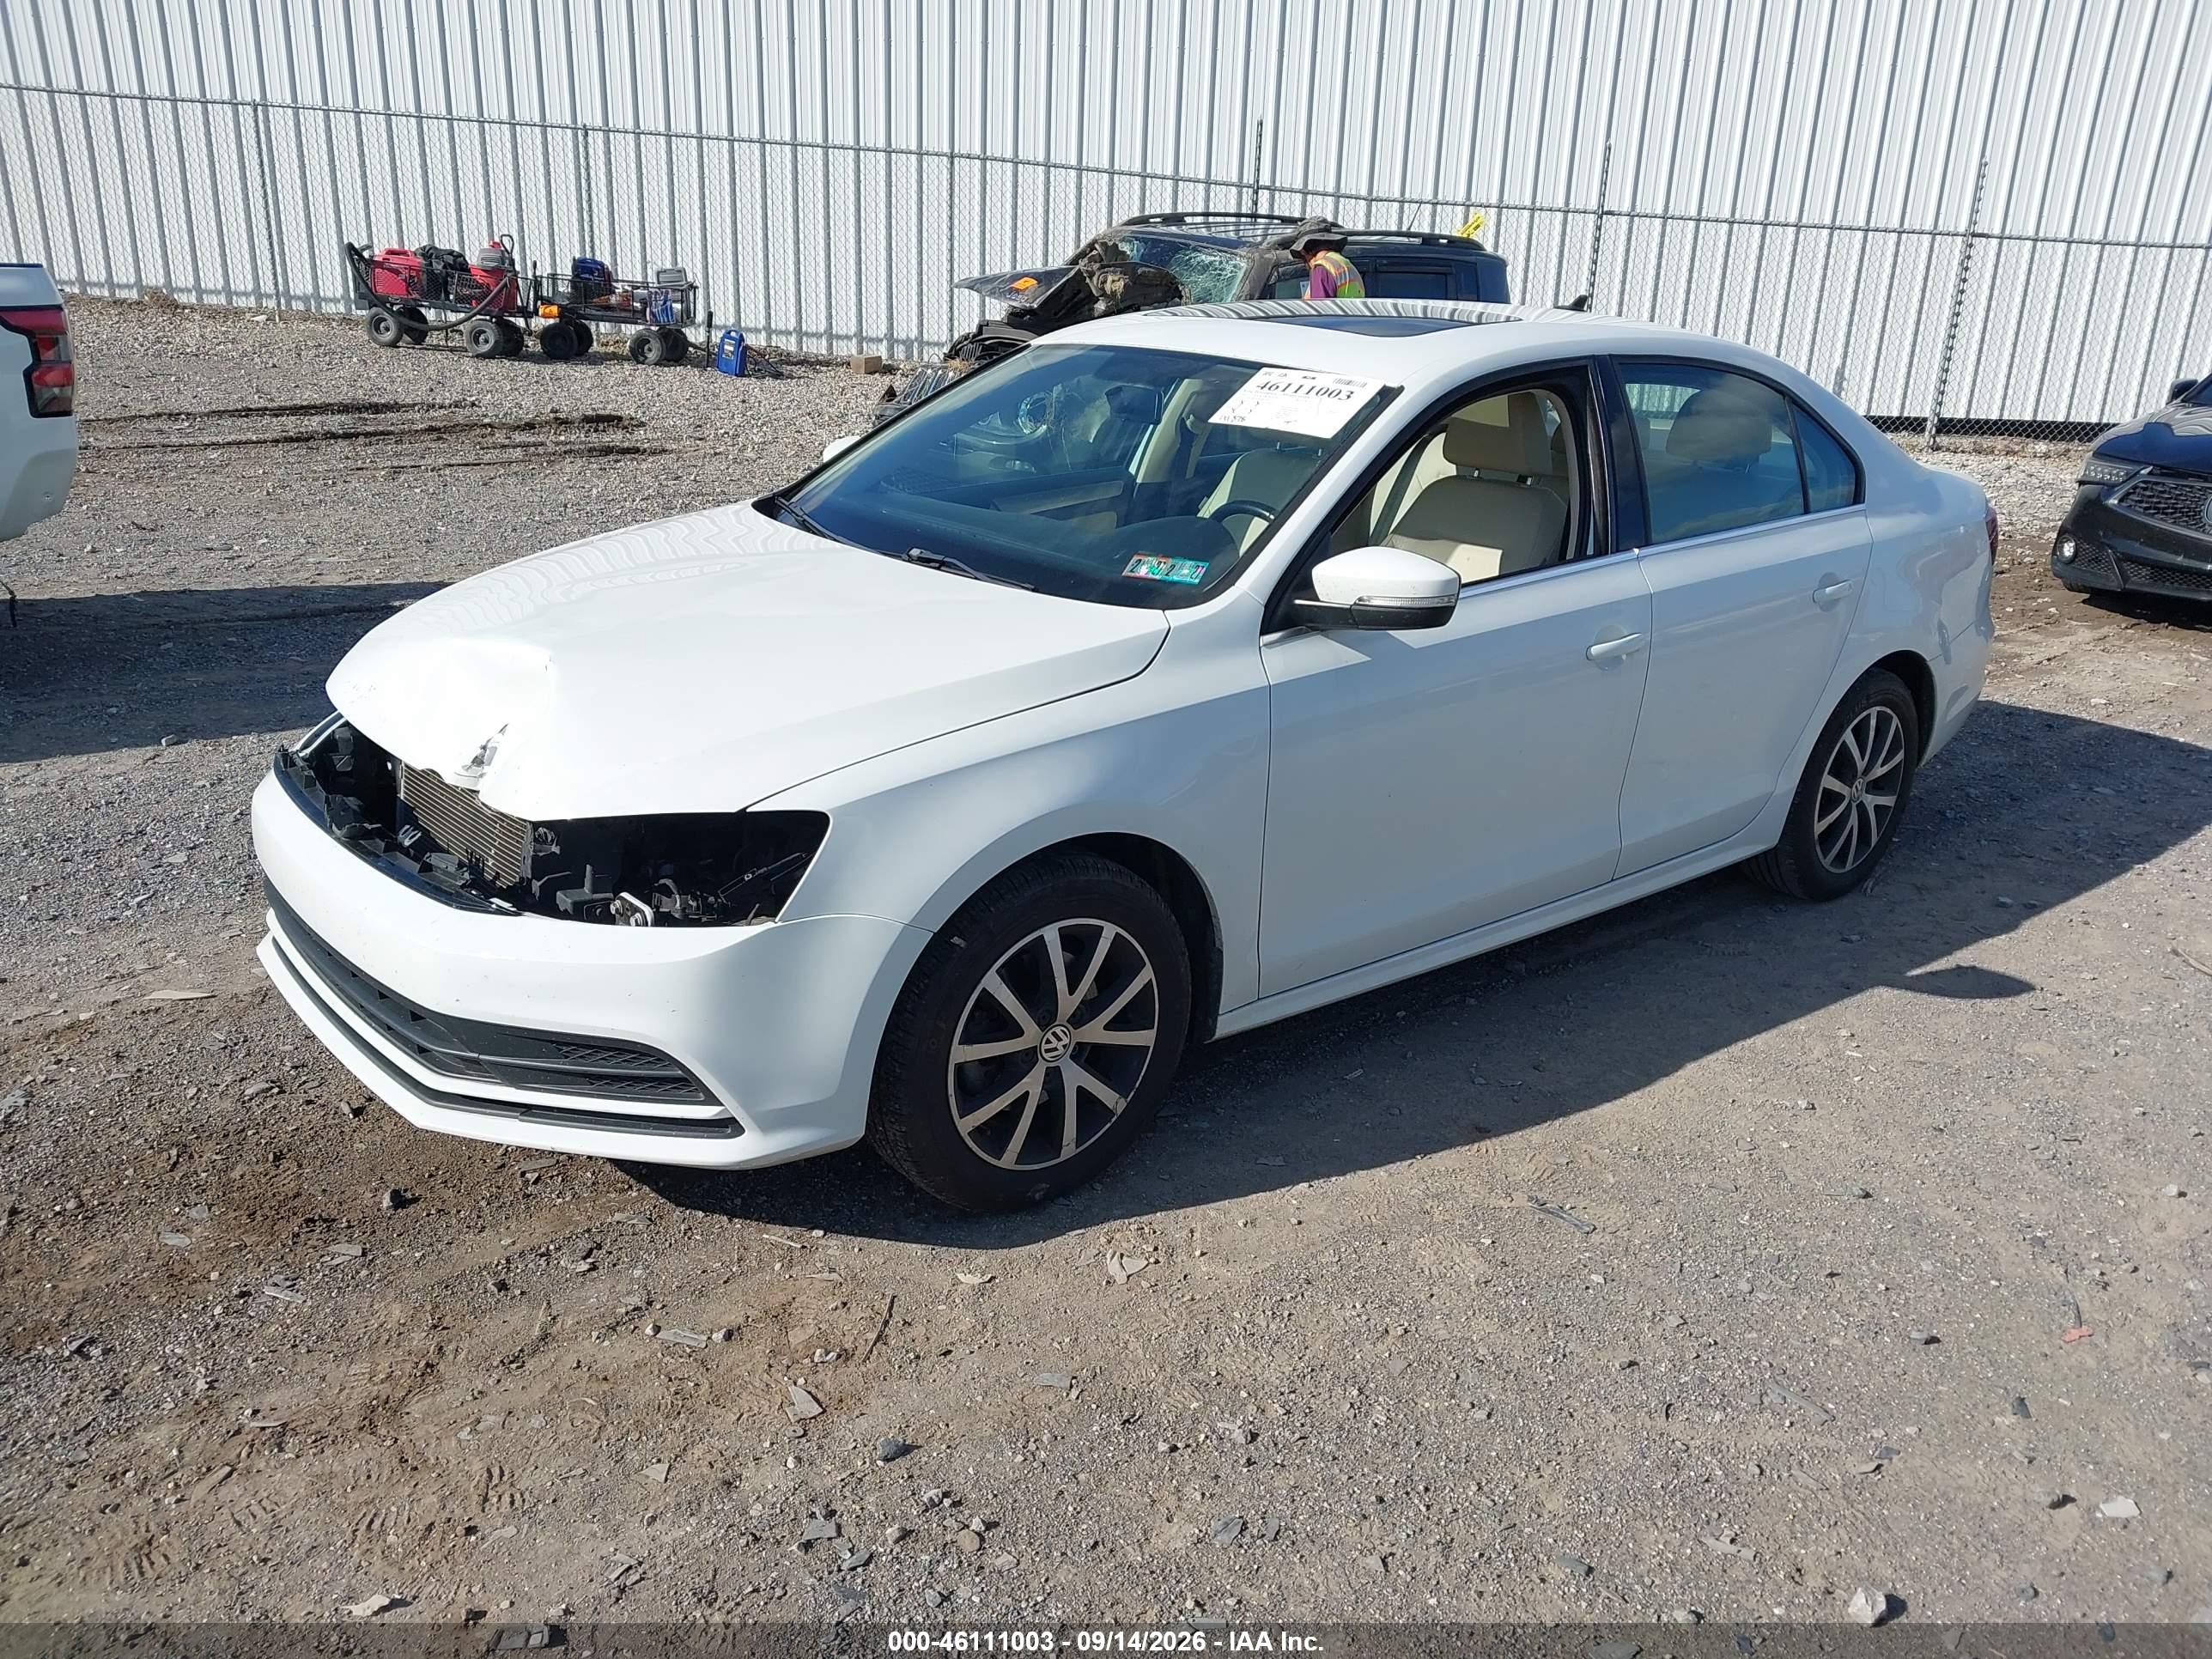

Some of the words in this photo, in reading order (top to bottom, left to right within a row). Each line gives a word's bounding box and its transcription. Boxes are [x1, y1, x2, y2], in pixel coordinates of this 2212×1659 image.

[1256, 380, 1354, 401] 46111003
[1129, 559, 1141, 573] 2
[1164, 564, 1176, 577] 2
[1191, 565, 1204, 579] 27
